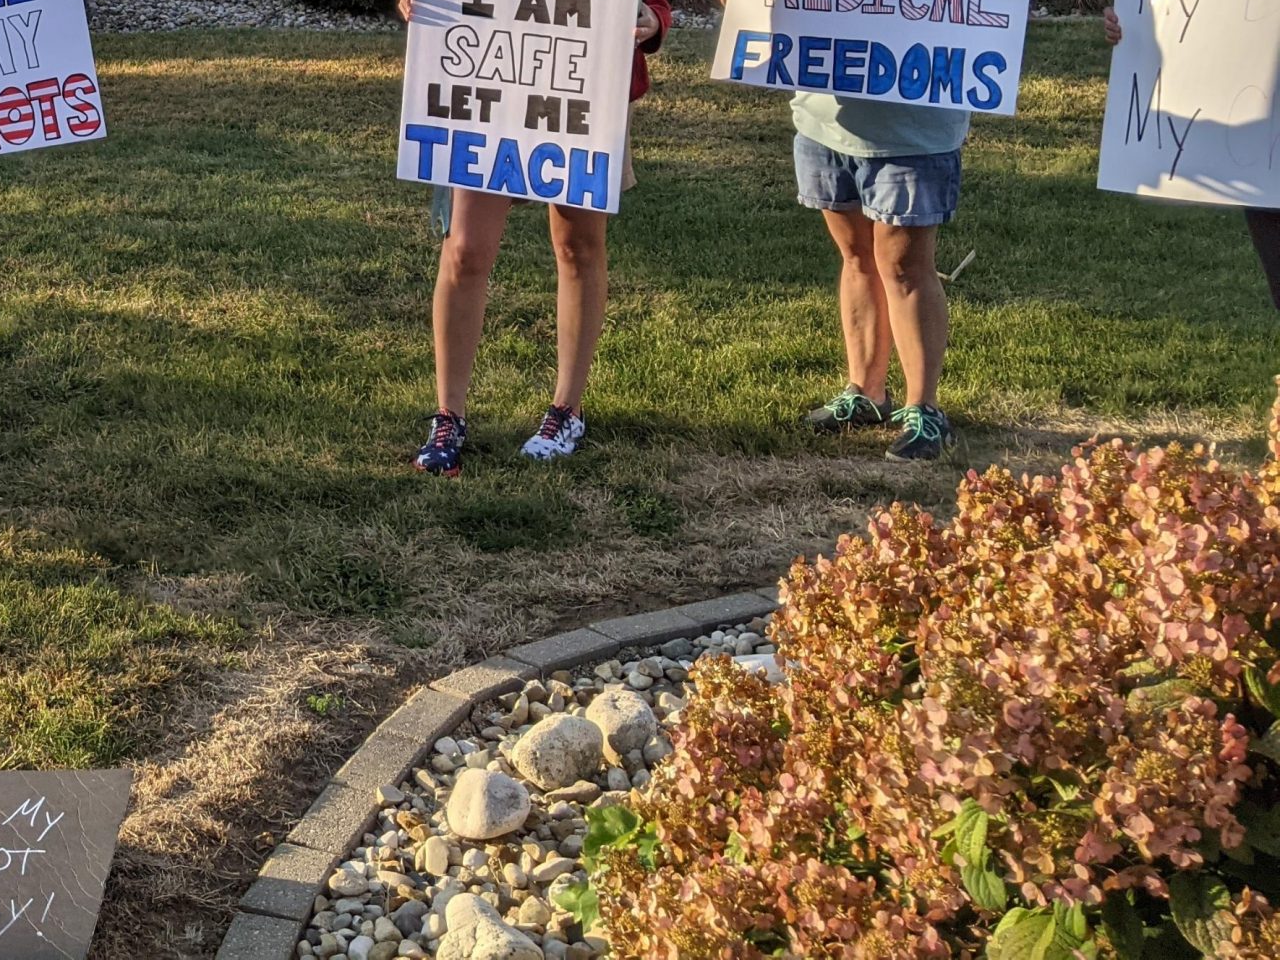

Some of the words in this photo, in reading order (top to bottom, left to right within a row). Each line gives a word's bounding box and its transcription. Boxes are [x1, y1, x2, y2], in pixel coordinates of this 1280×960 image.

[440, 24, 587, 94] SAFE
[730, 29, 1007, 111] FREEDOMS
[427, 82, 502, 123] LET
[524, 95, 590, 135] ME
[405, 123, 610, 210] TEACH
